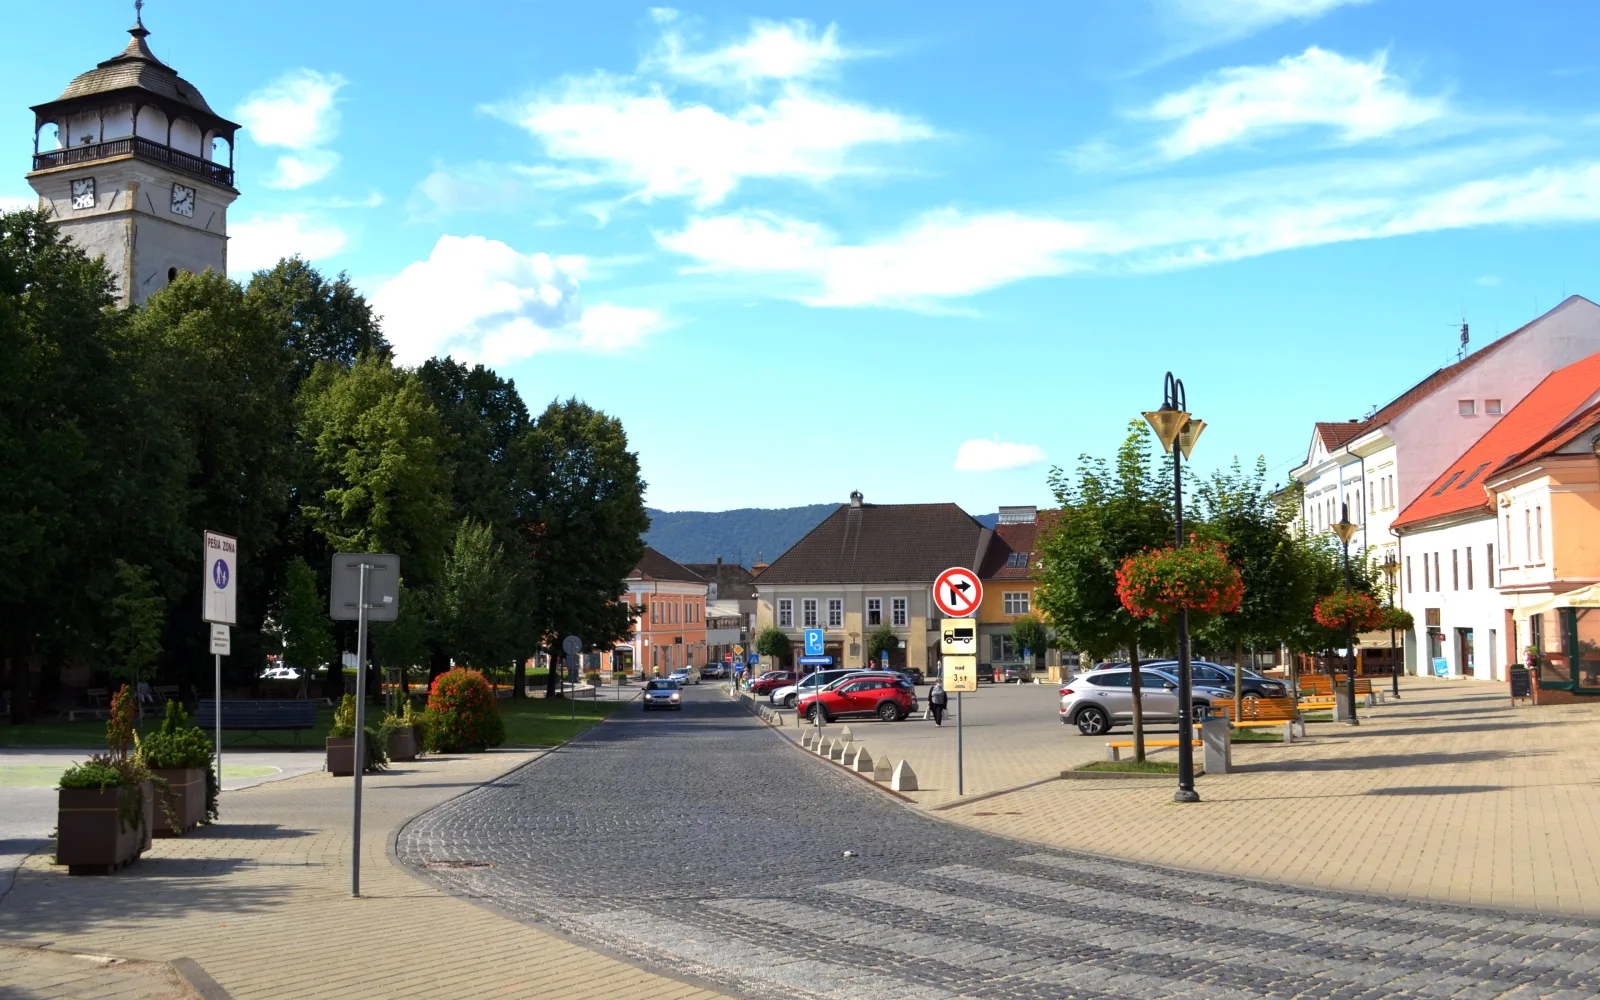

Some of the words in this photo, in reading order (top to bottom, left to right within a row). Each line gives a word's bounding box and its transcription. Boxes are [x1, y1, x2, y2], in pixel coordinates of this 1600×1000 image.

[208, 536, 221, 550] PEŠIA
[222, 540, 235, 553] ZÓNA
[810, 632, 818, 647] P
